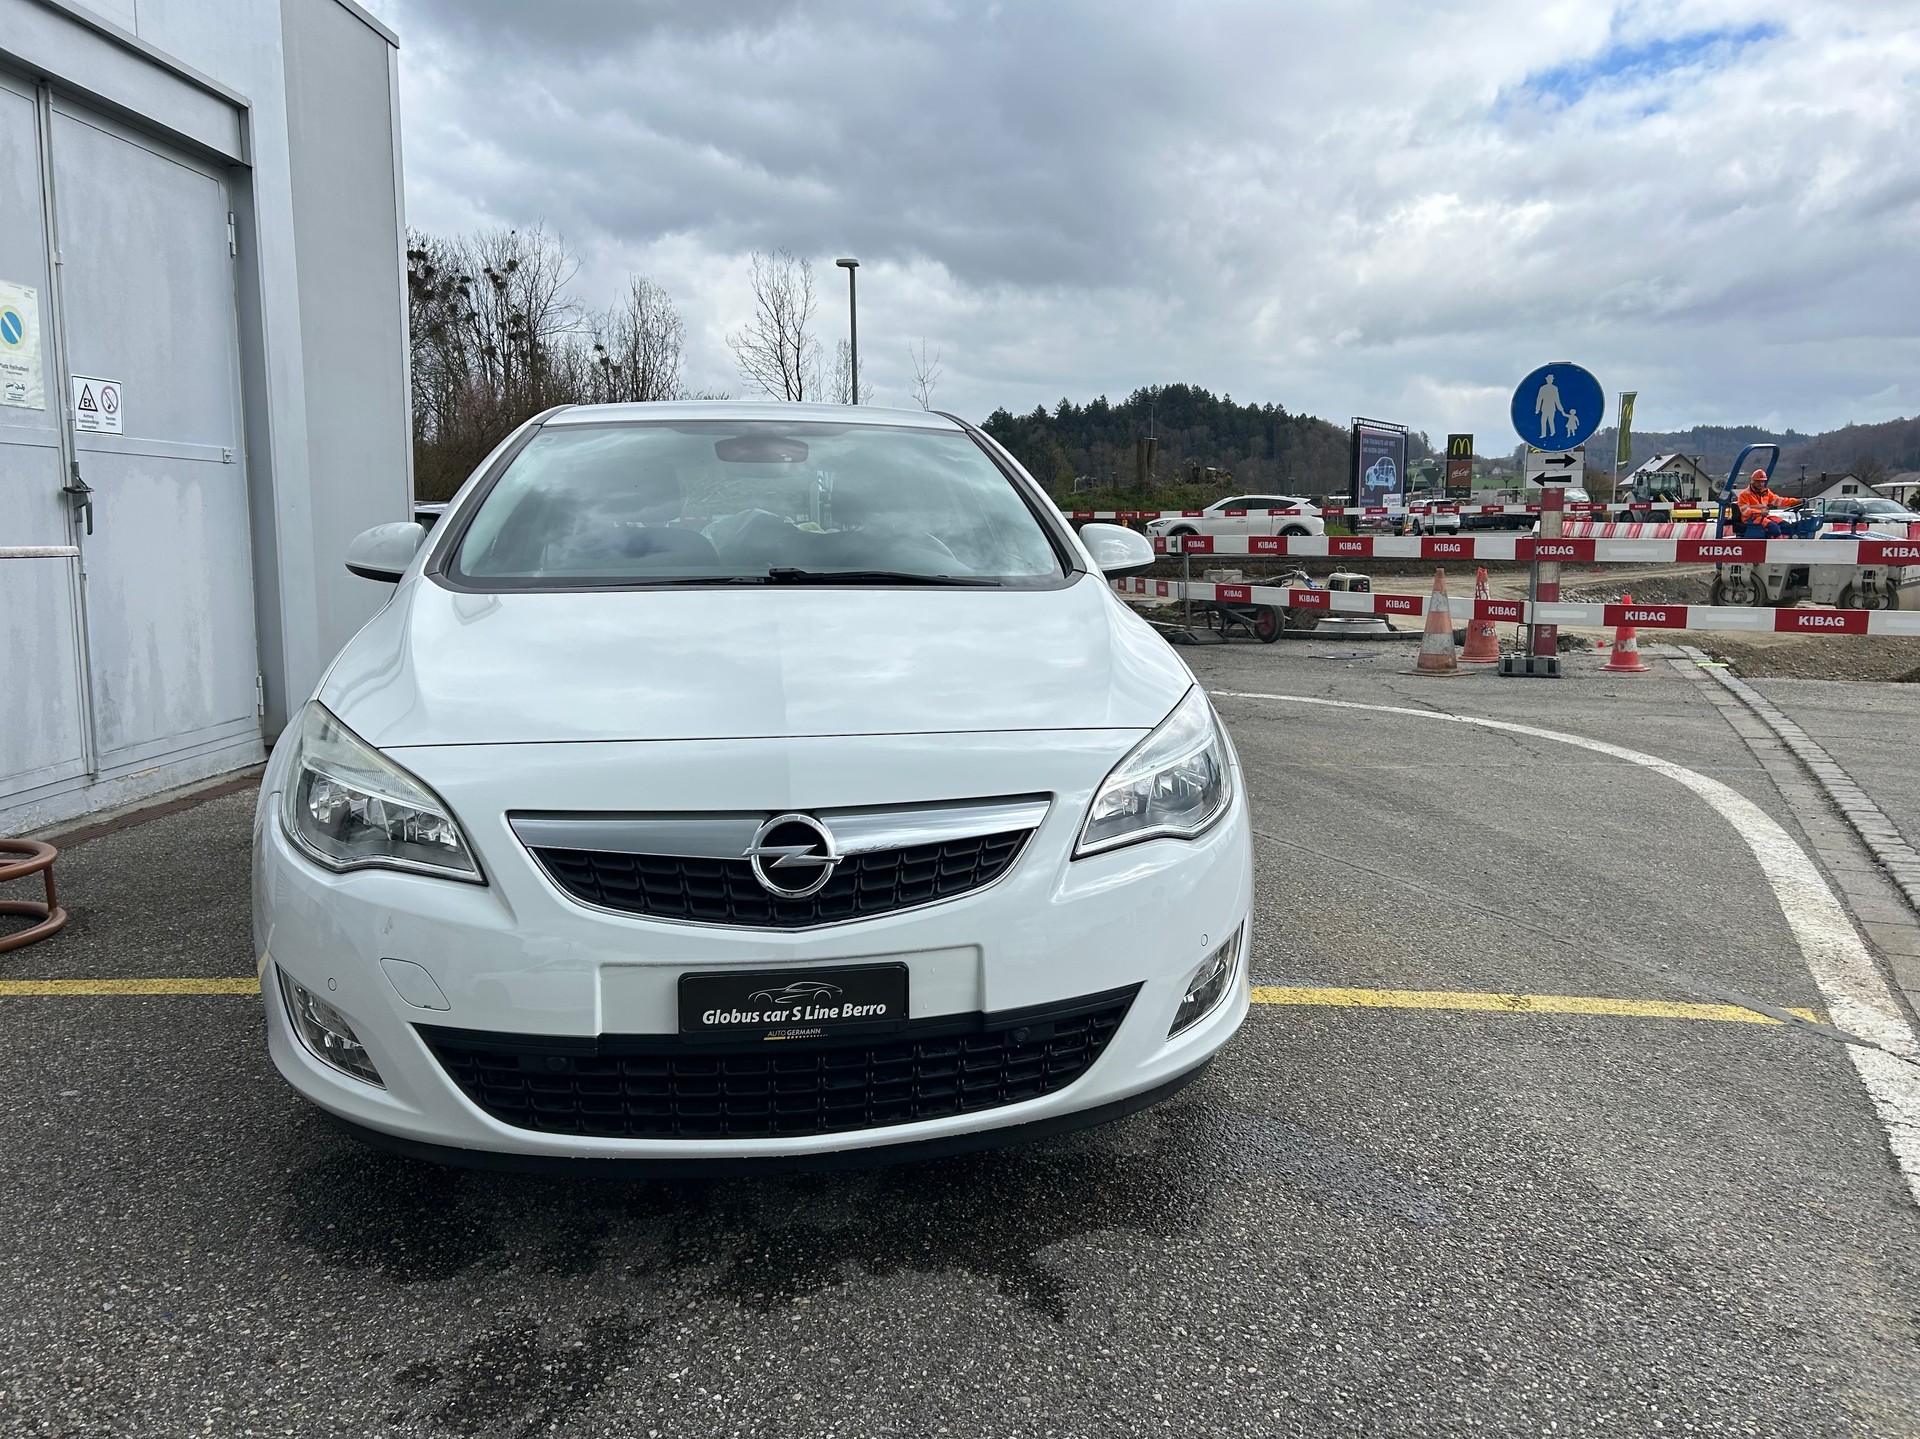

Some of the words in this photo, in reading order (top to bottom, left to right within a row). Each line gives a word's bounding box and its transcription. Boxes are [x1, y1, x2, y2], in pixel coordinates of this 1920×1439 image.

[83, 397, 92, 408] EX
[1187, 540, 1206, 548] KIBAG
[1257, 541, 1278, 549] KIBAG
[1338, 542, 1362, 551] KIBAG
[1433, 543, 1461, 552] KIBAG
[1535, 545, 1575, 555] KIBAG
[1698, 546, 1743, 556] KIBAG
[1881, 547, 1920, 558] KIBA
[1223, 589, 1243, 598] KIBAG
[1298, 594, 1320, 603] KIBAG
[1385, 599, 1411, 609] KIBAG
[1487, 605, 1517, 616] KIBAG
[1624, 610, 1666, 622] KIBAG
[1798, 615, 1845, 627] KIBAG
[702, 1008, 760, 1025] Globus
[763, 1009, 789, 1022] car
[791, 1006, 802, 1021] S
[804, 1003, 839, 1020] Line
[842, 1002, 887, 1017] Berro
